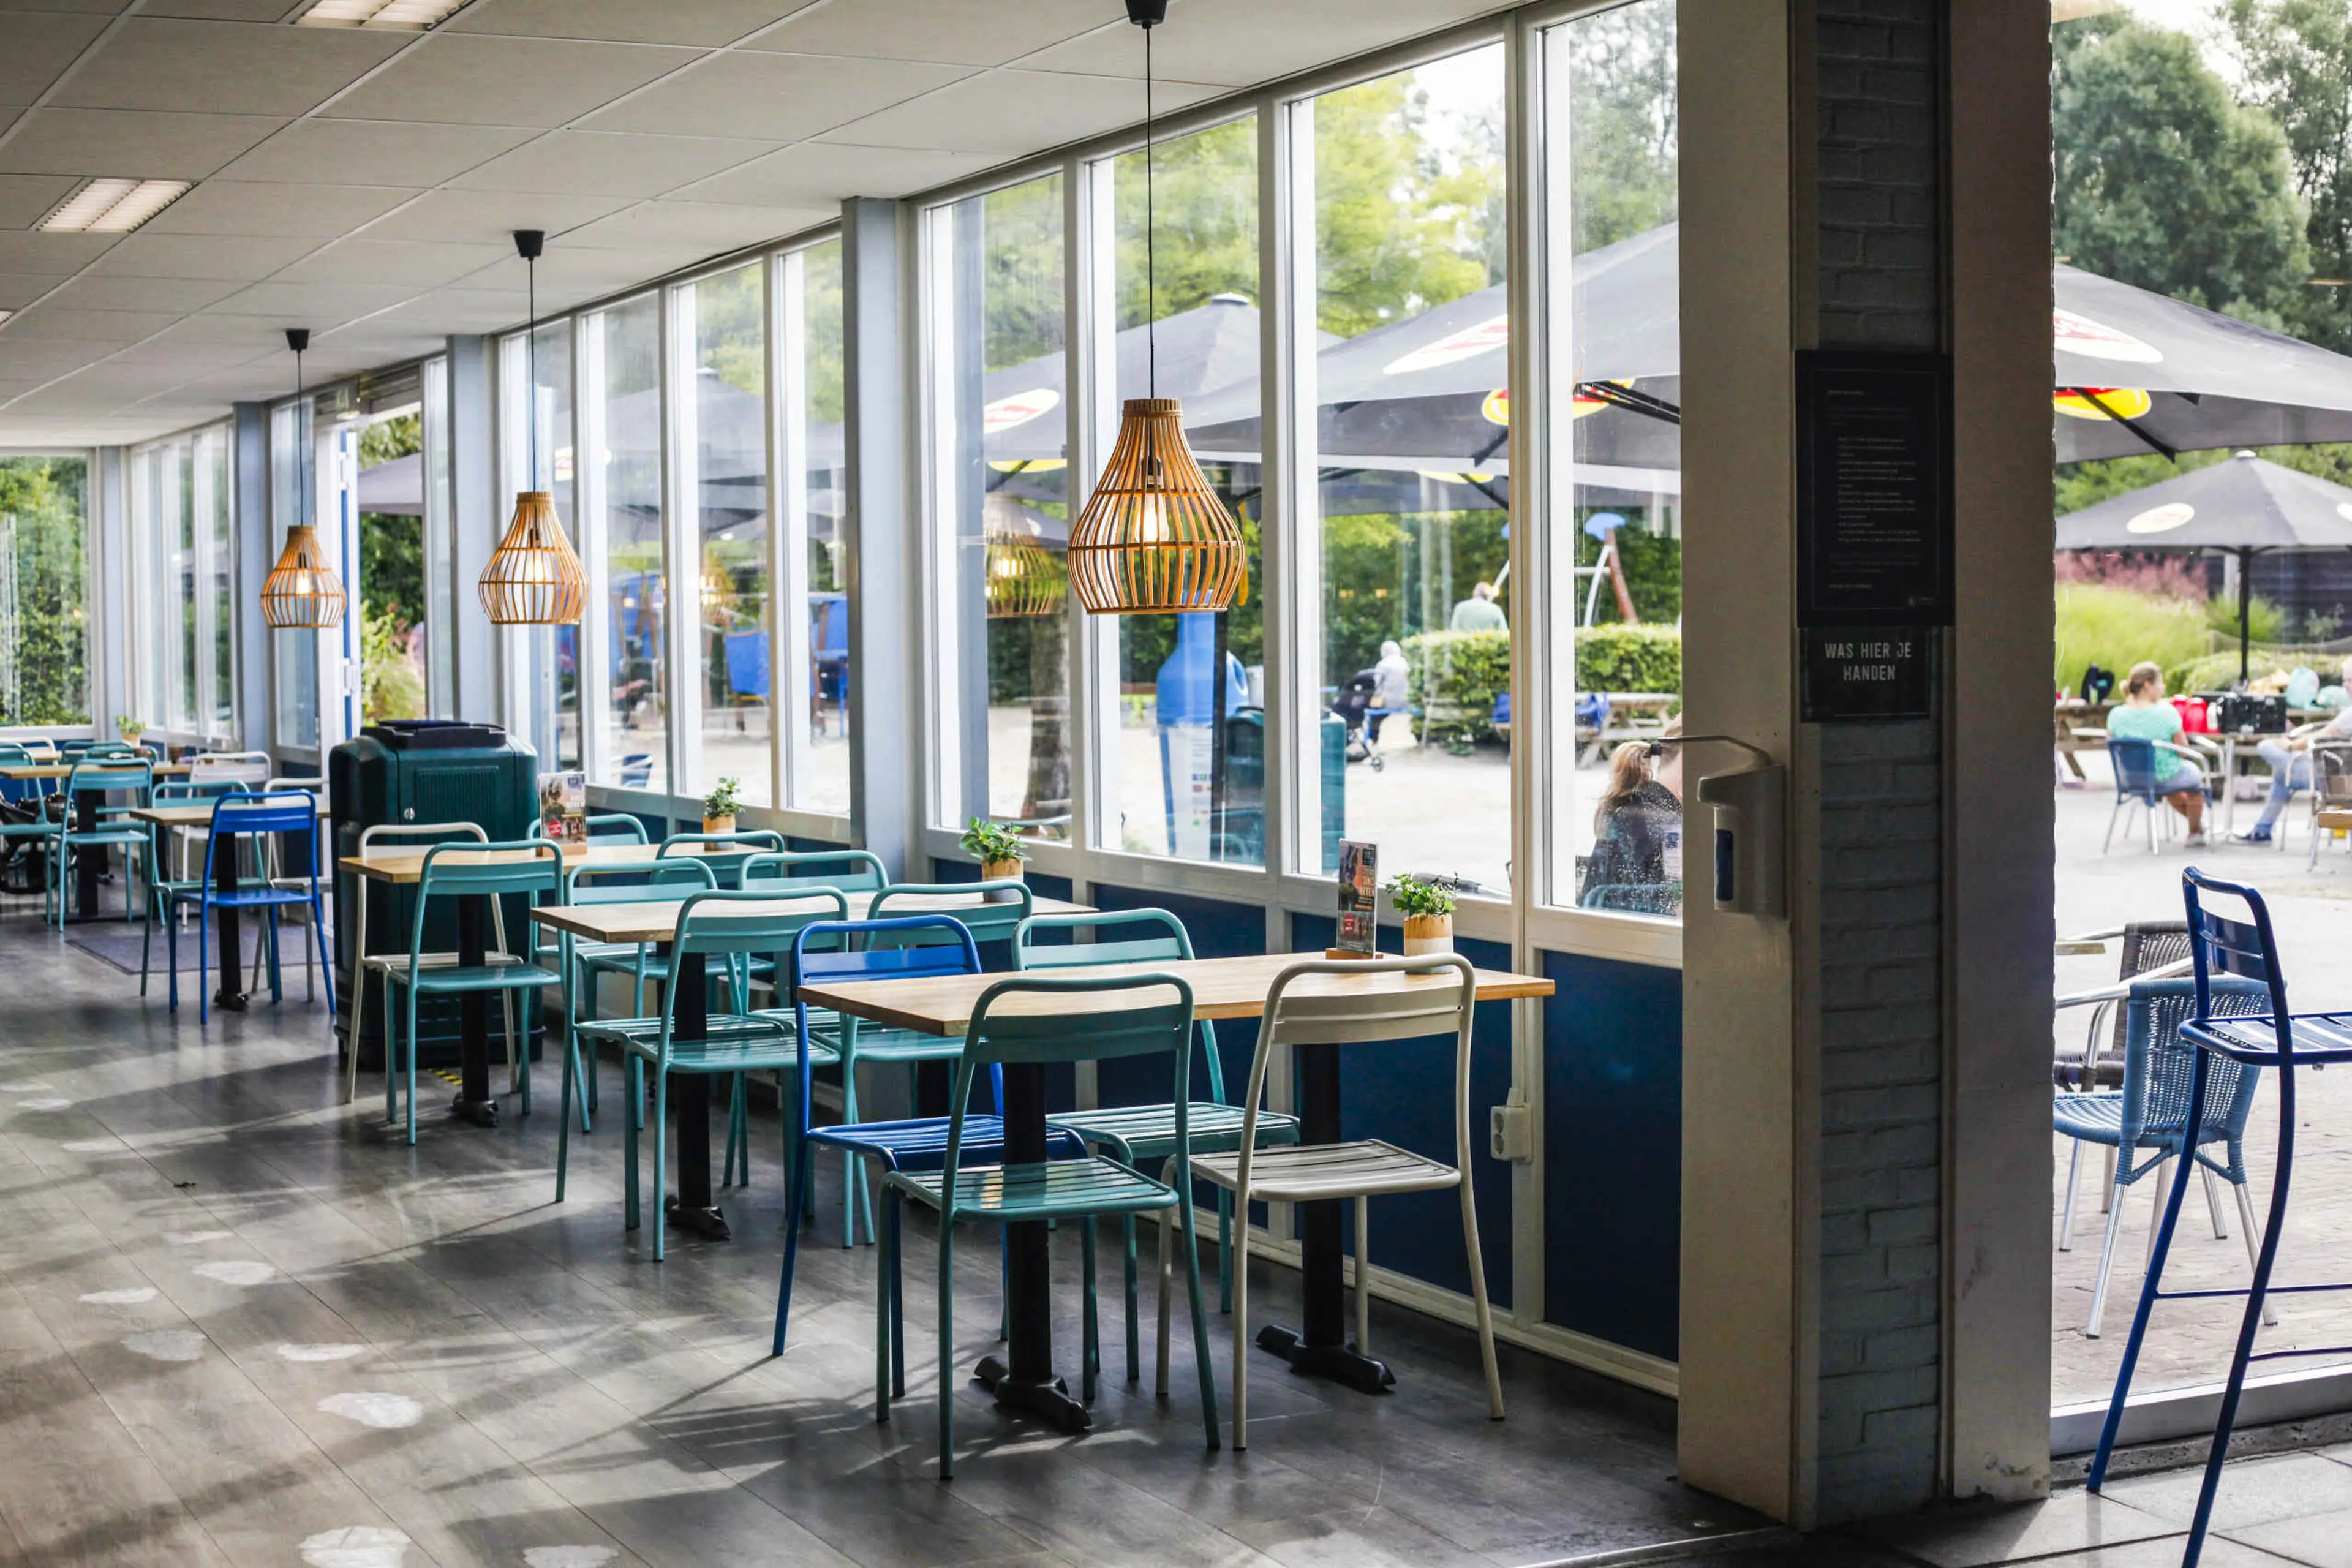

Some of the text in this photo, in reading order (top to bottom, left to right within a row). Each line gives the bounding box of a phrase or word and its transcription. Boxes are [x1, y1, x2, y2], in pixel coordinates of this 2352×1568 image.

[1824, 641, 1912, 659] WAS HIER JE
[1843, 665, 1896, 681] HANDEN
